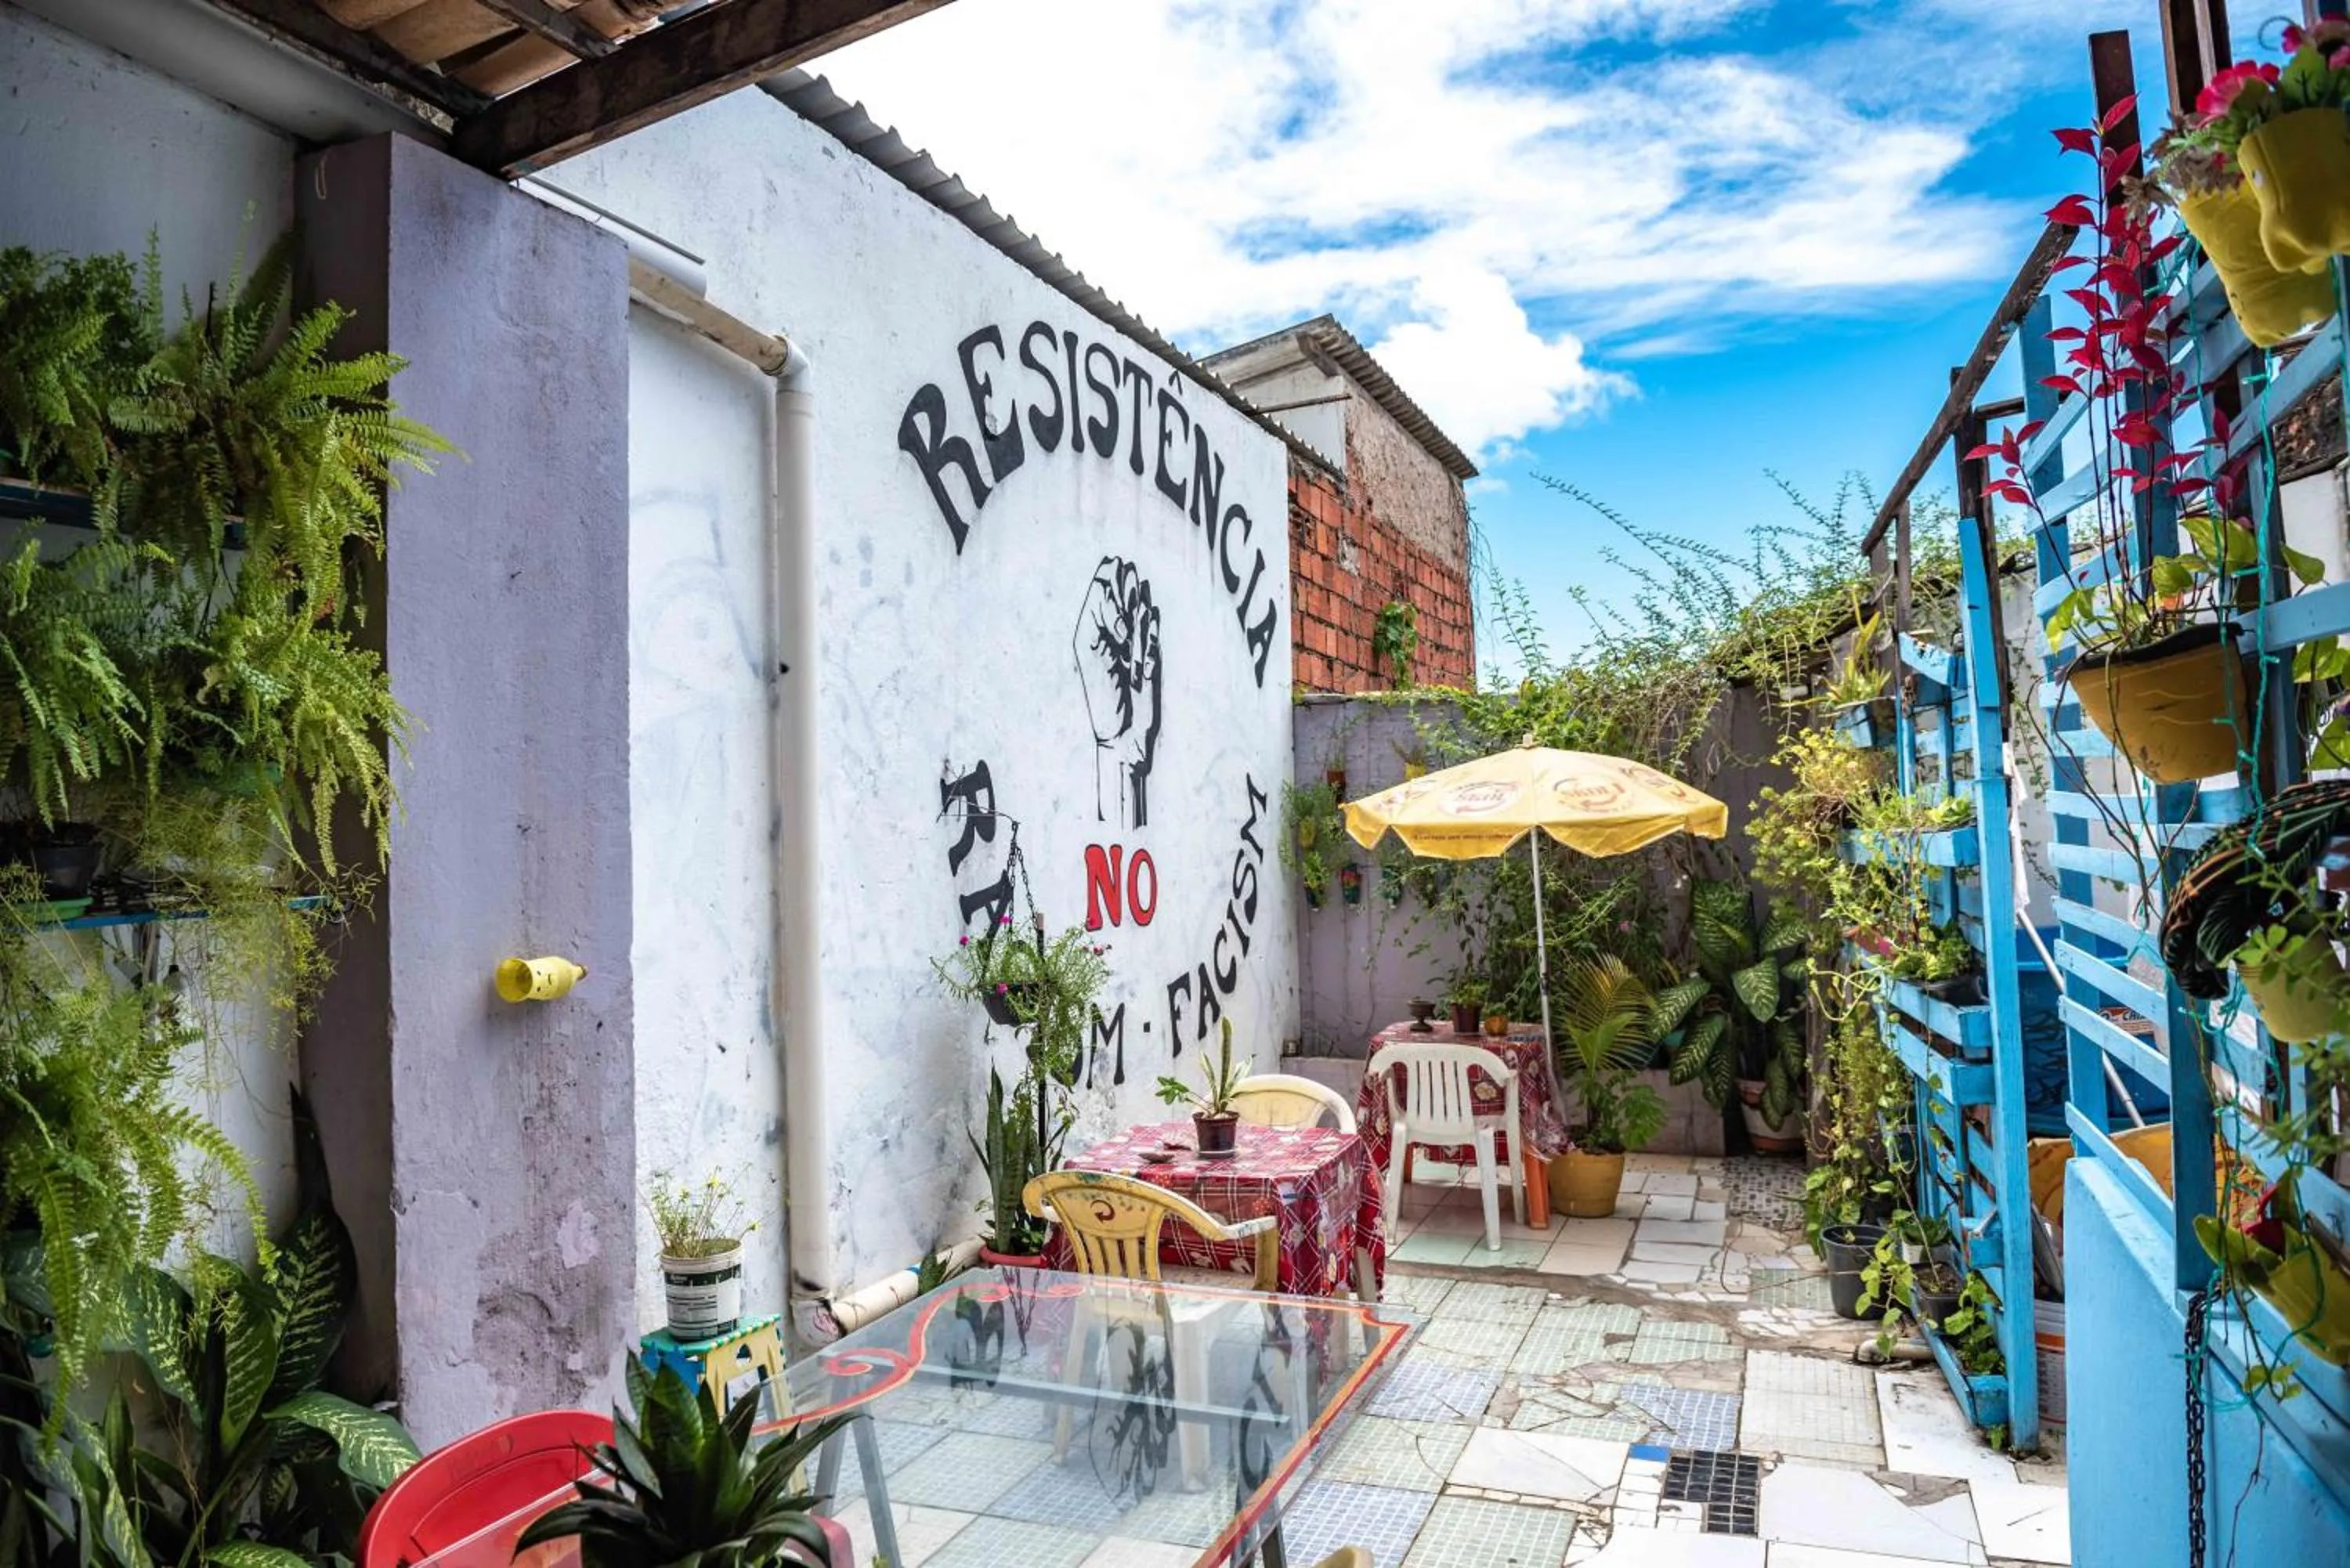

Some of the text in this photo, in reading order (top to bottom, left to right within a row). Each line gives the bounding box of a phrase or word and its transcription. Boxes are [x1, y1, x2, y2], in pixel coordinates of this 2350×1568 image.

[897, 320, 1277, 688] RESISTÊNCIA
[1084, 844, 1158, 931] NO
[1166, 772, 1268, 1059] FACISM
